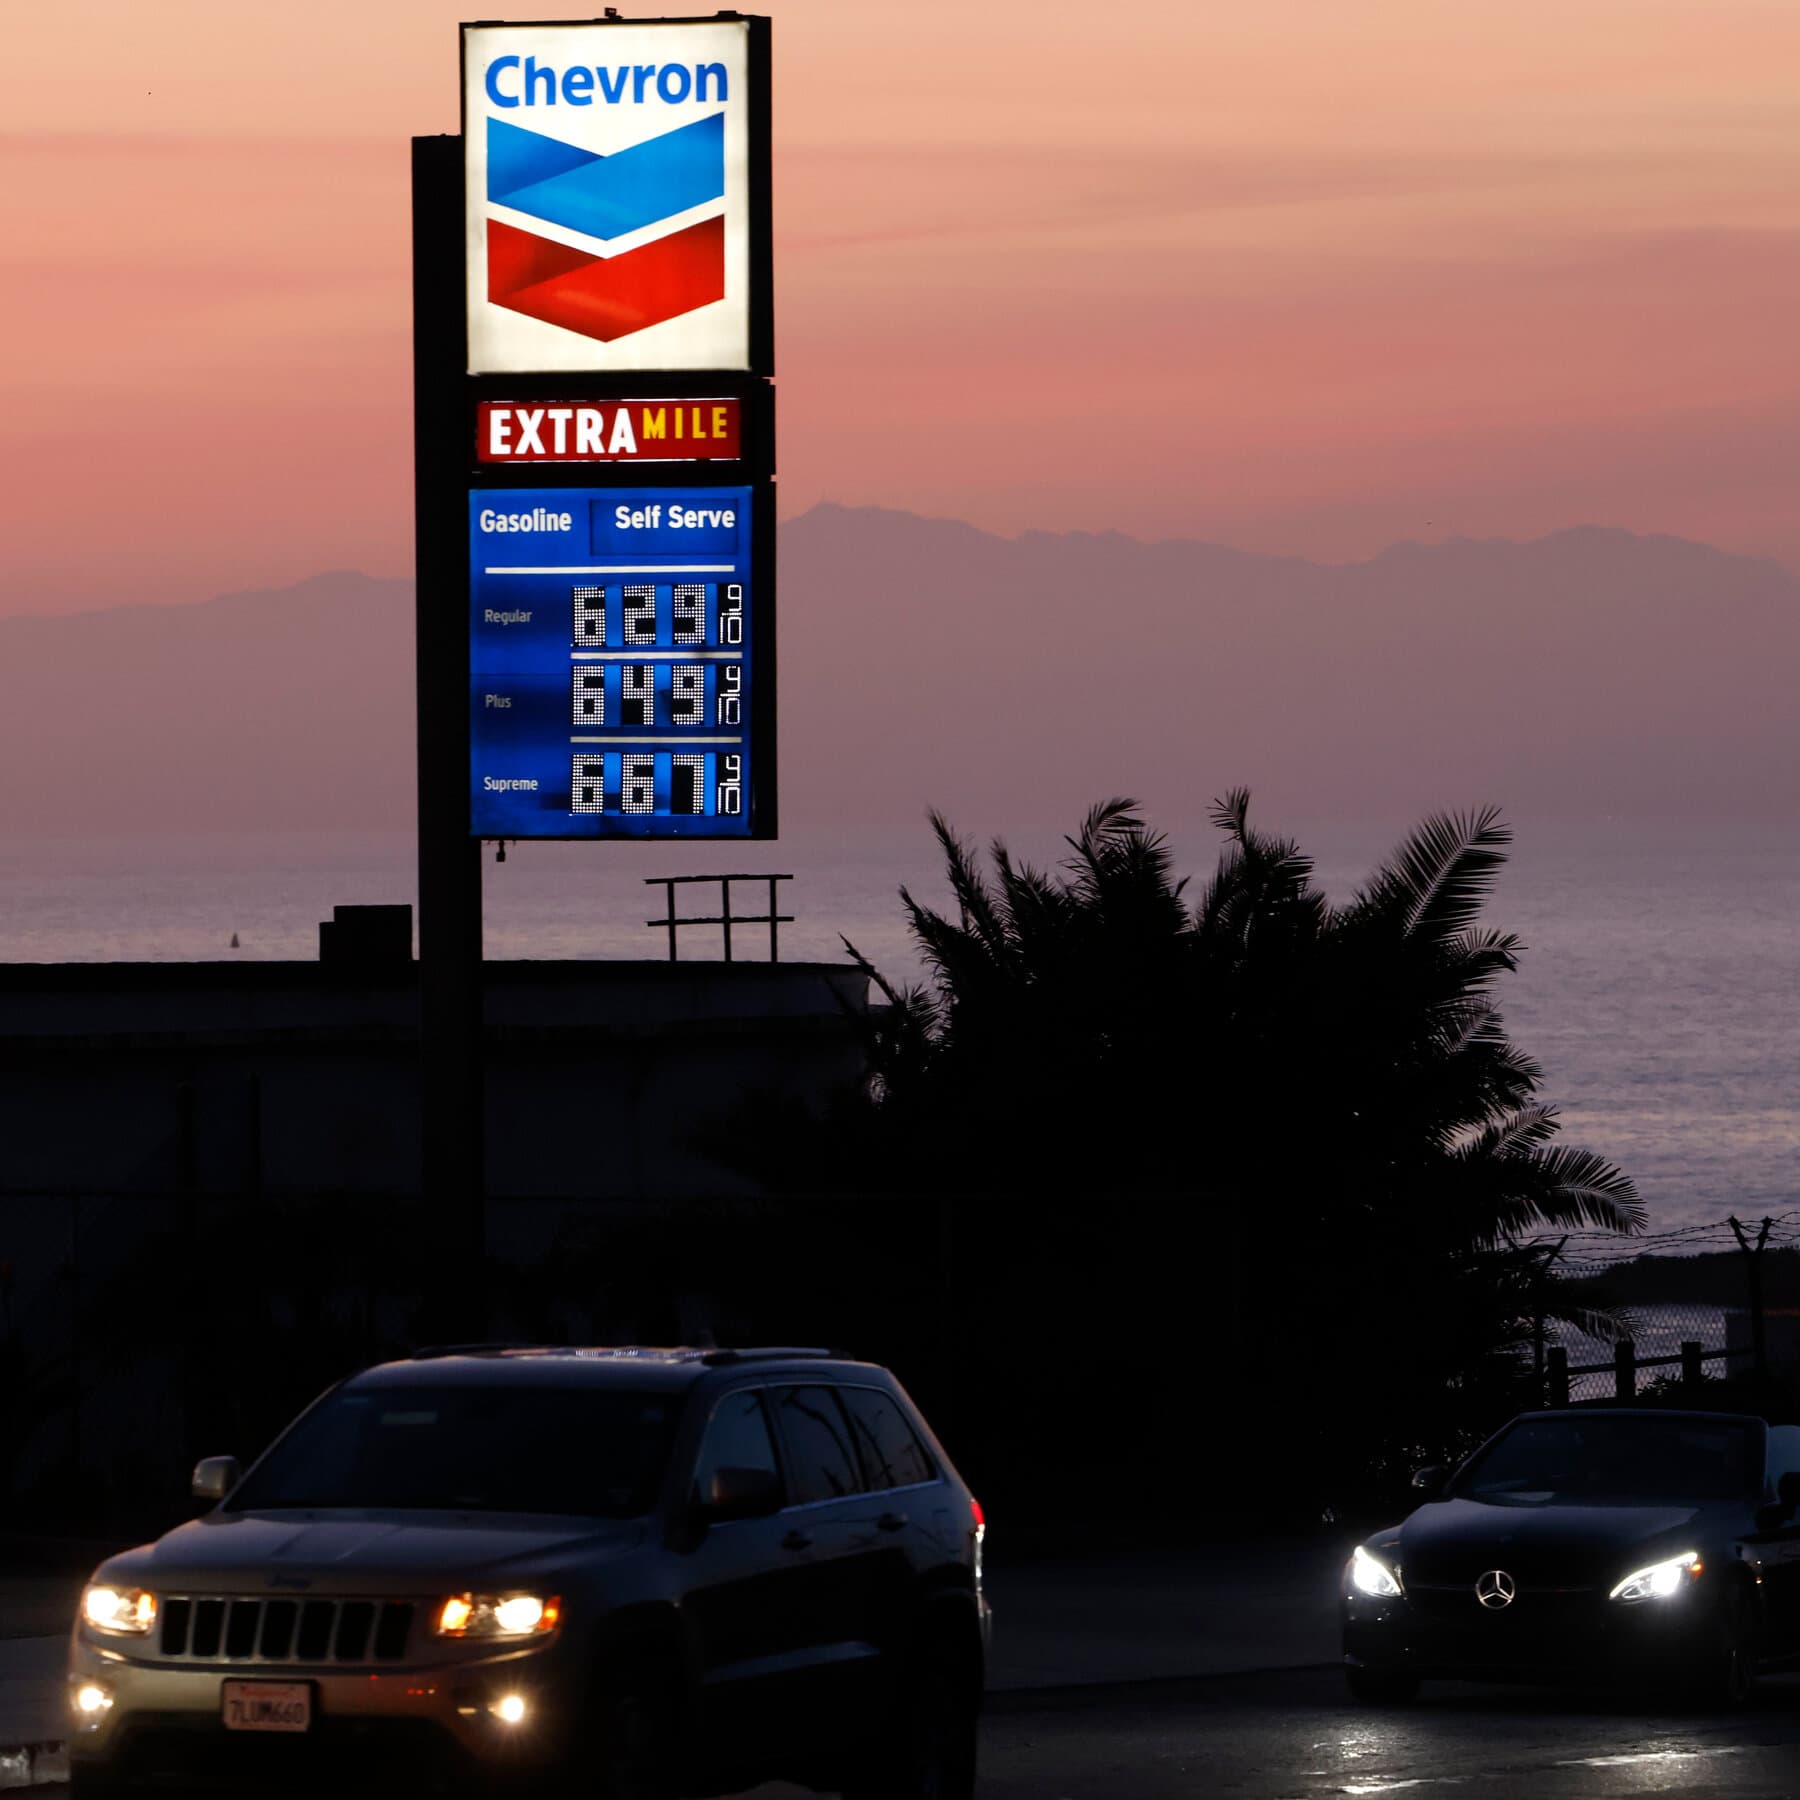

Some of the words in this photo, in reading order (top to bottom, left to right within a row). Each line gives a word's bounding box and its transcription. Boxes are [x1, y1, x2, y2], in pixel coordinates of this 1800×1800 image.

[485, 55, 728, 108] Chevron
[489, 409, 638, 456] EXTRA
[642, 407, 729, 440] MILE
[480, 508, 572, 534] Gasoline
[615, 505, 661, 529] Self
[668, 505, 735, 529] Serve
[484, 609, 532, 626] Regular
[572, 585, 706, 647] 629
[485, 694, 512, 709] Plus
[572, 665, 705, 726] 649
[483, 777, 538, 792] Supreme
[572, 754, 705, 815] 667
